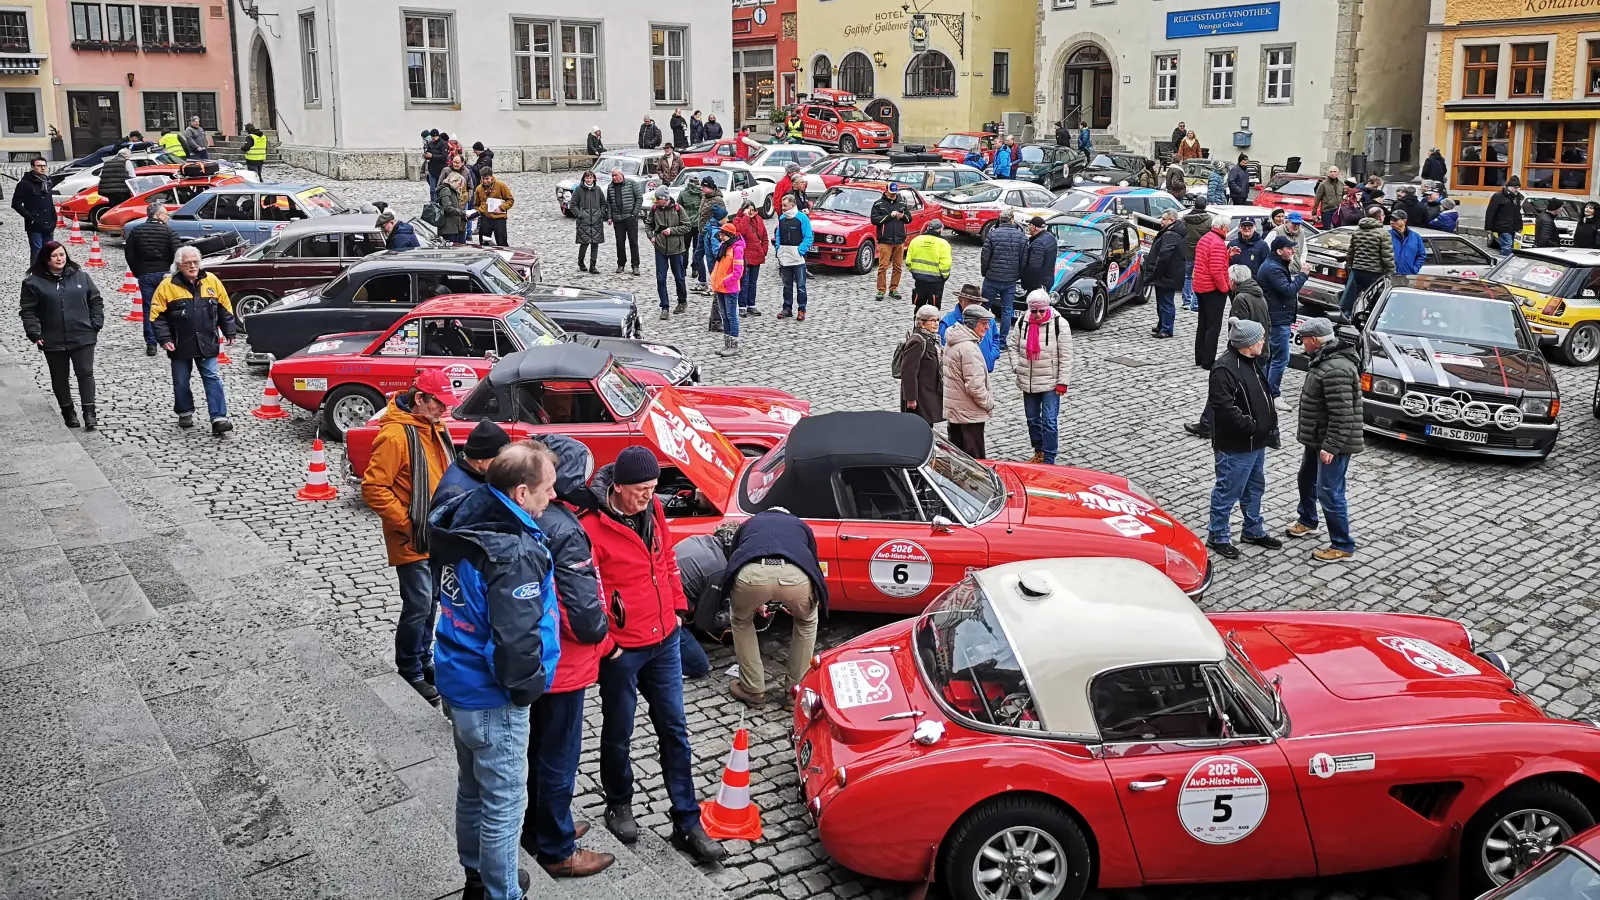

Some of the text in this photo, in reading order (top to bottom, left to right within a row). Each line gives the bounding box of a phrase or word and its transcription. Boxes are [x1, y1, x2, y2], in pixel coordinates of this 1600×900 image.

[875, 11, 905, 20] HOTEL
[1173, 7, 1272, 24] REICHSSTADT-VINOTHEK
[873, 20, 909, 35] Goldenes
[1539, 317, 1570, 326] MICHELIN
[1404, 400, 1424, 409] Hella
[1437, 406, 1457, 414] Hella
[1466, 411, 1487, 419] Hella
[1431, 425, 1488, 443] MA SC 890H
[891, 544, 914, 554] 2026
[893, 564, 909, 585] 6
[520, 584, 540, 597] Ford
[1207, 763, 1239, 776] 2026
[1189, 776, 1259, 787] AvD-Histo-Monte
[1212, 794, 1233, 823] 5
